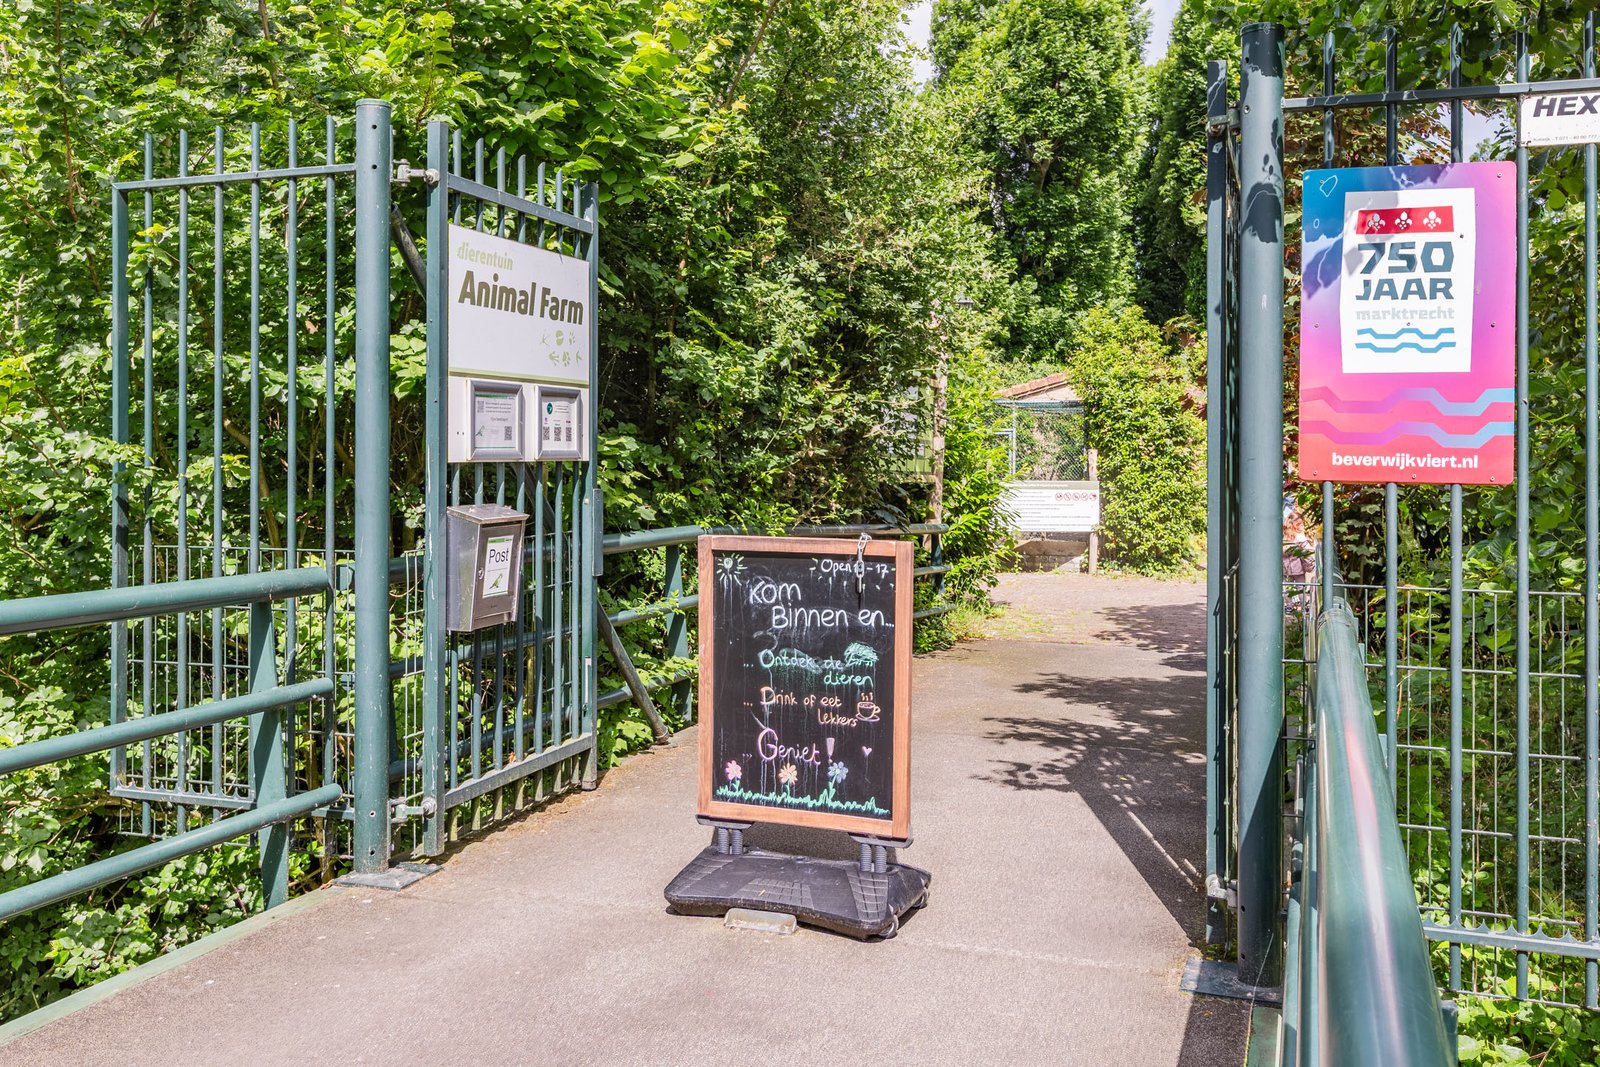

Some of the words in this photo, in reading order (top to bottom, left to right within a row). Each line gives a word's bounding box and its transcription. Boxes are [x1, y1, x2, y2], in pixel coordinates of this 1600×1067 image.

[456, 242, 514, 271] dierentuin
[1357, 241, 1455, 274] 750
[458, 270, 537, 317] Animal
[539, 287, 584, 325] Farm
[1355, 277, 1455, 301] JAAR
[1356, 306, 1455, 321] marktrecht
[1331, 452, 1479, 470] beverwijkviert.nl
[489, 547, 509, 564] Post
[821, 559, 852, 577] Open
[772, 603, 849, 628] Binnen
[824, 655, 843, 670] de
[823, 671, 874, 688] dieren
[760, 686, 798, 705] Drink
[803, 694, 817, 707] of
[820, 696, 843, 707] eet
